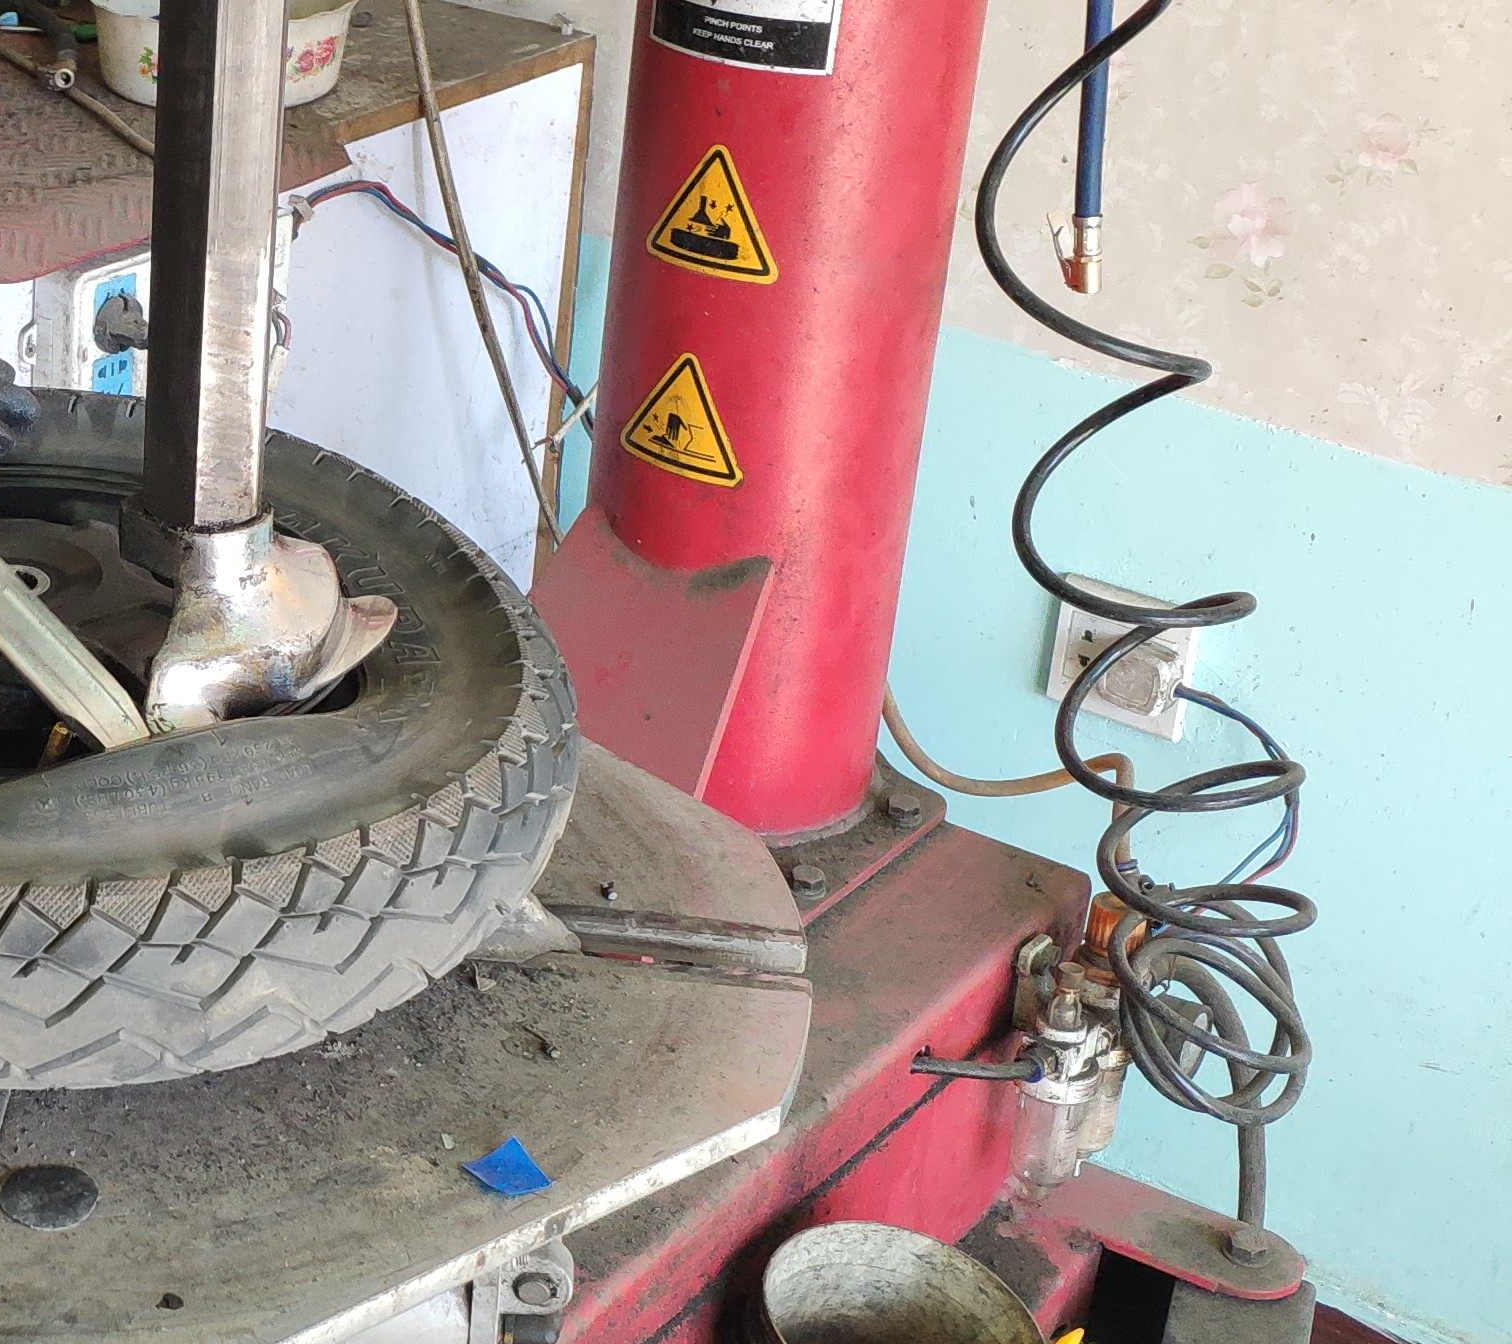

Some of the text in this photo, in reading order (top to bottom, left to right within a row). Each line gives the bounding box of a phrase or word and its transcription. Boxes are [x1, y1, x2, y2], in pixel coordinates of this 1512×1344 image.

[704, 16, 764, 34] PINCH POINTS
[692, 27, 775, 50] KEEP HANDS CLEAR
